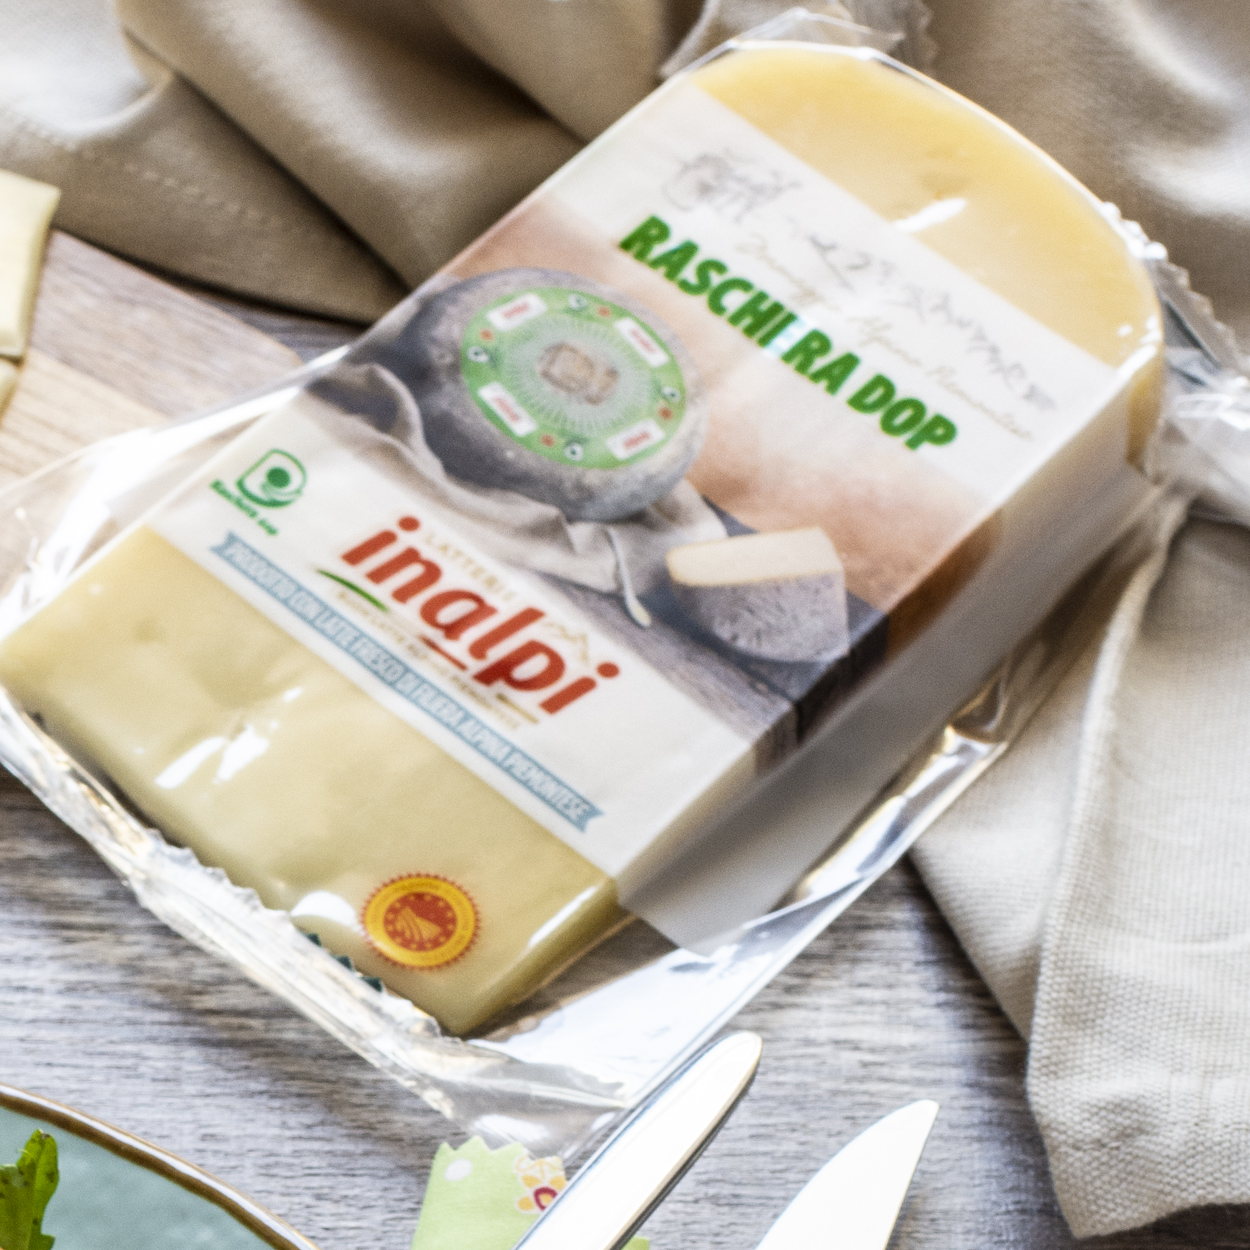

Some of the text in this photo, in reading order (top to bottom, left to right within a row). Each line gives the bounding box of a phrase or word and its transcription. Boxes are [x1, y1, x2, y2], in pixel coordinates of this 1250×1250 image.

[846, 373, 959, 452] DOP
[287, 592, 322, 620] CON
[313, 611, 358, 647] LATTE
[340, 515, 621, 716] inalpi
